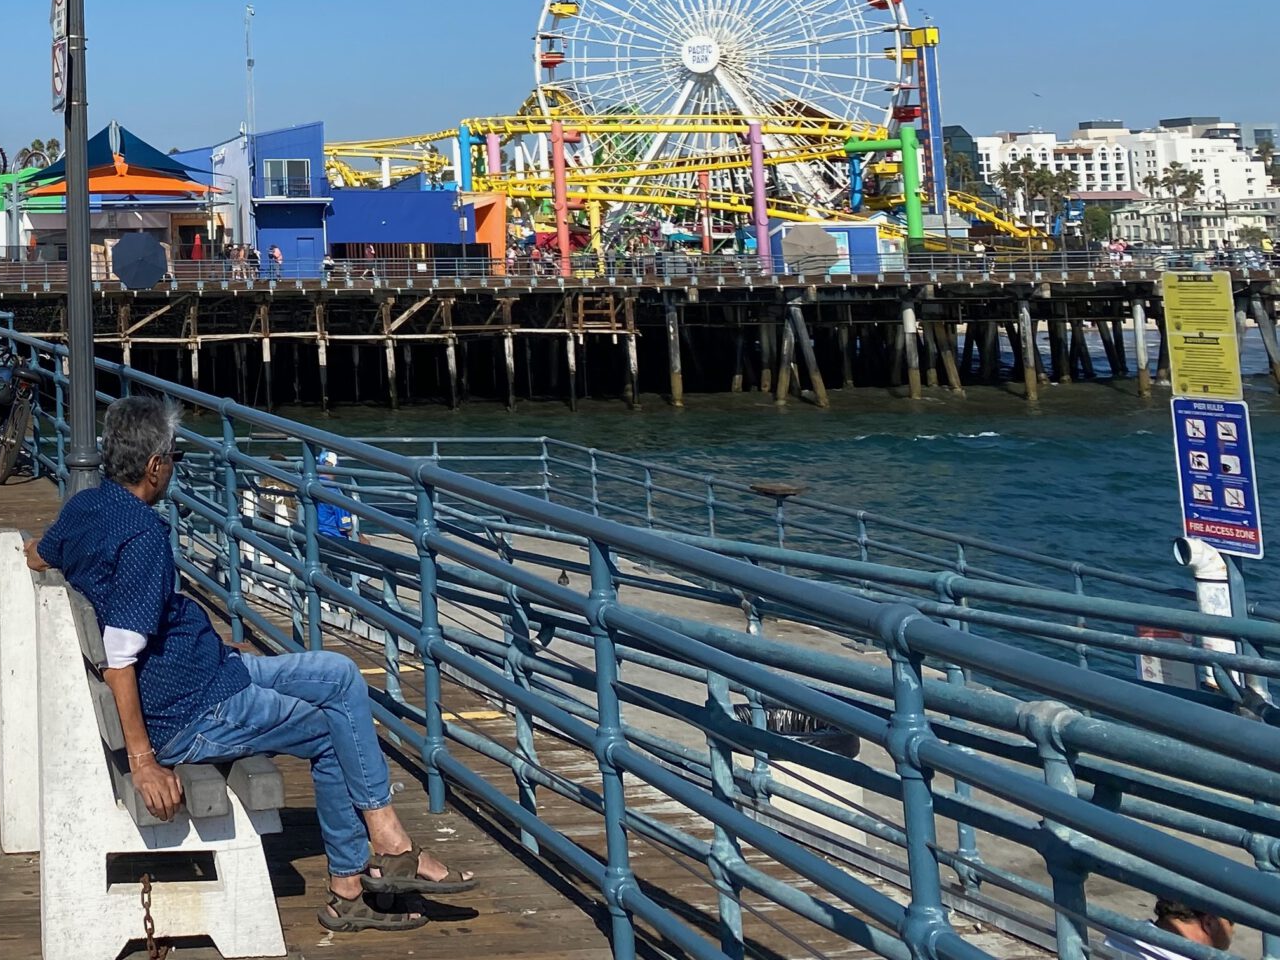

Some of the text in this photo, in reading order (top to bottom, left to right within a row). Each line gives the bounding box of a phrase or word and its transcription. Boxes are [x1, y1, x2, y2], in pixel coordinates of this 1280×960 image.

[688, 45, 712, 54] PACIFIC
[692, 55, 709, 64] PARK
[1189, 522, 1256, 540] FIRE ACCESS ZONE
